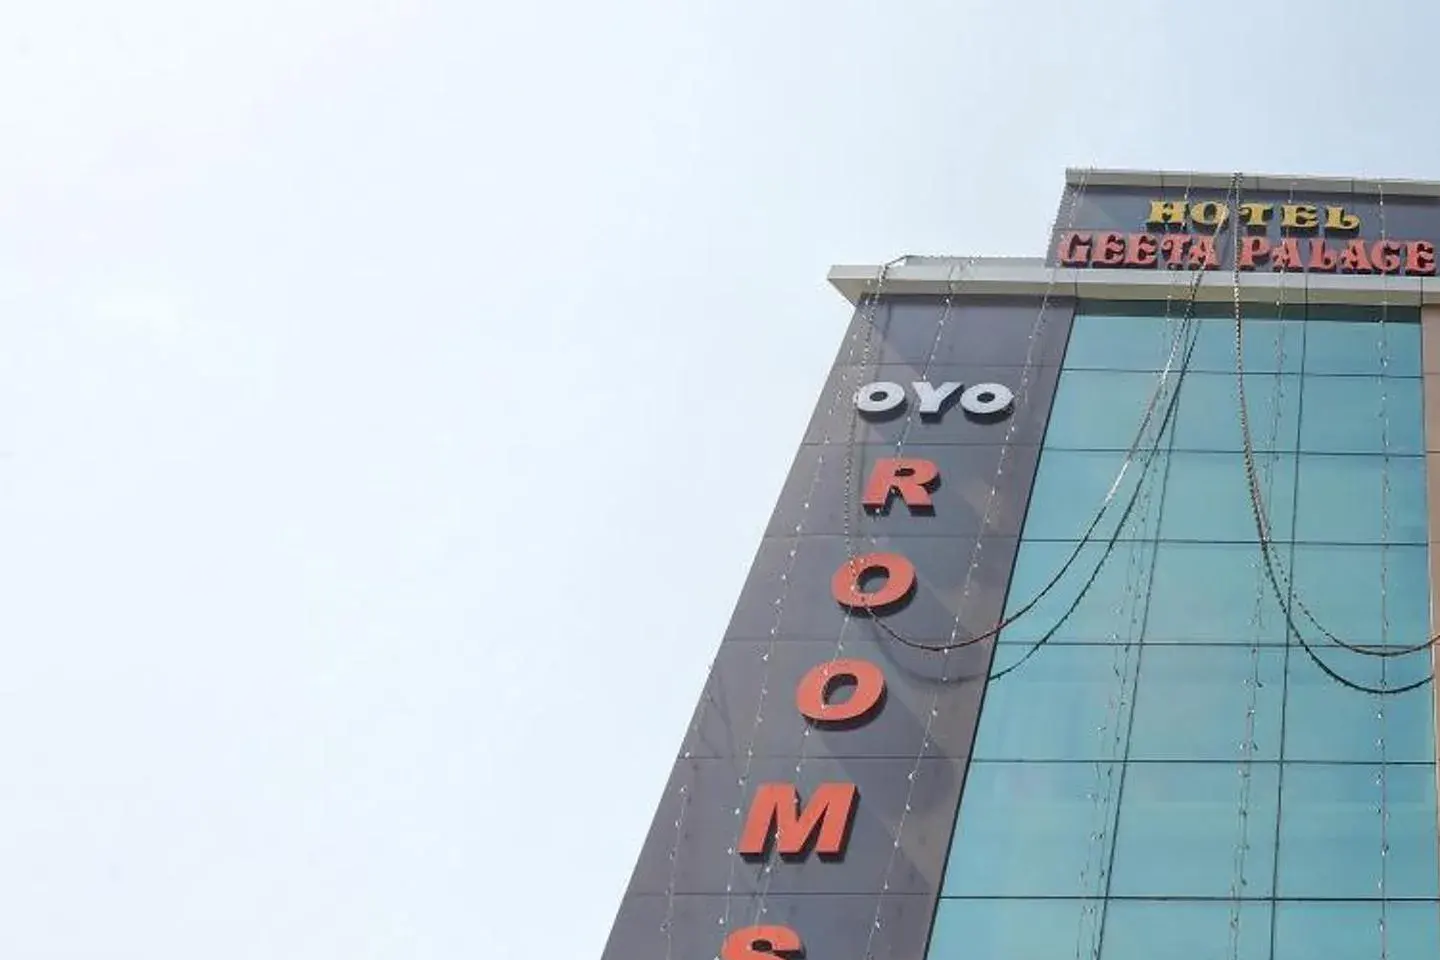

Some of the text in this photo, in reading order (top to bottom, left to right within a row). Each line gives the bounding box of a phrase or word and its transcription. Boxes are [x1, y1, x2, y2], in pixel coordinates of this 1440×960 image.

[1146, 199, 1360, 231] HOTEL
[1057, 231, 1437, 275] GEETA PALACE
[853, 380, 1016, 417] OYO
